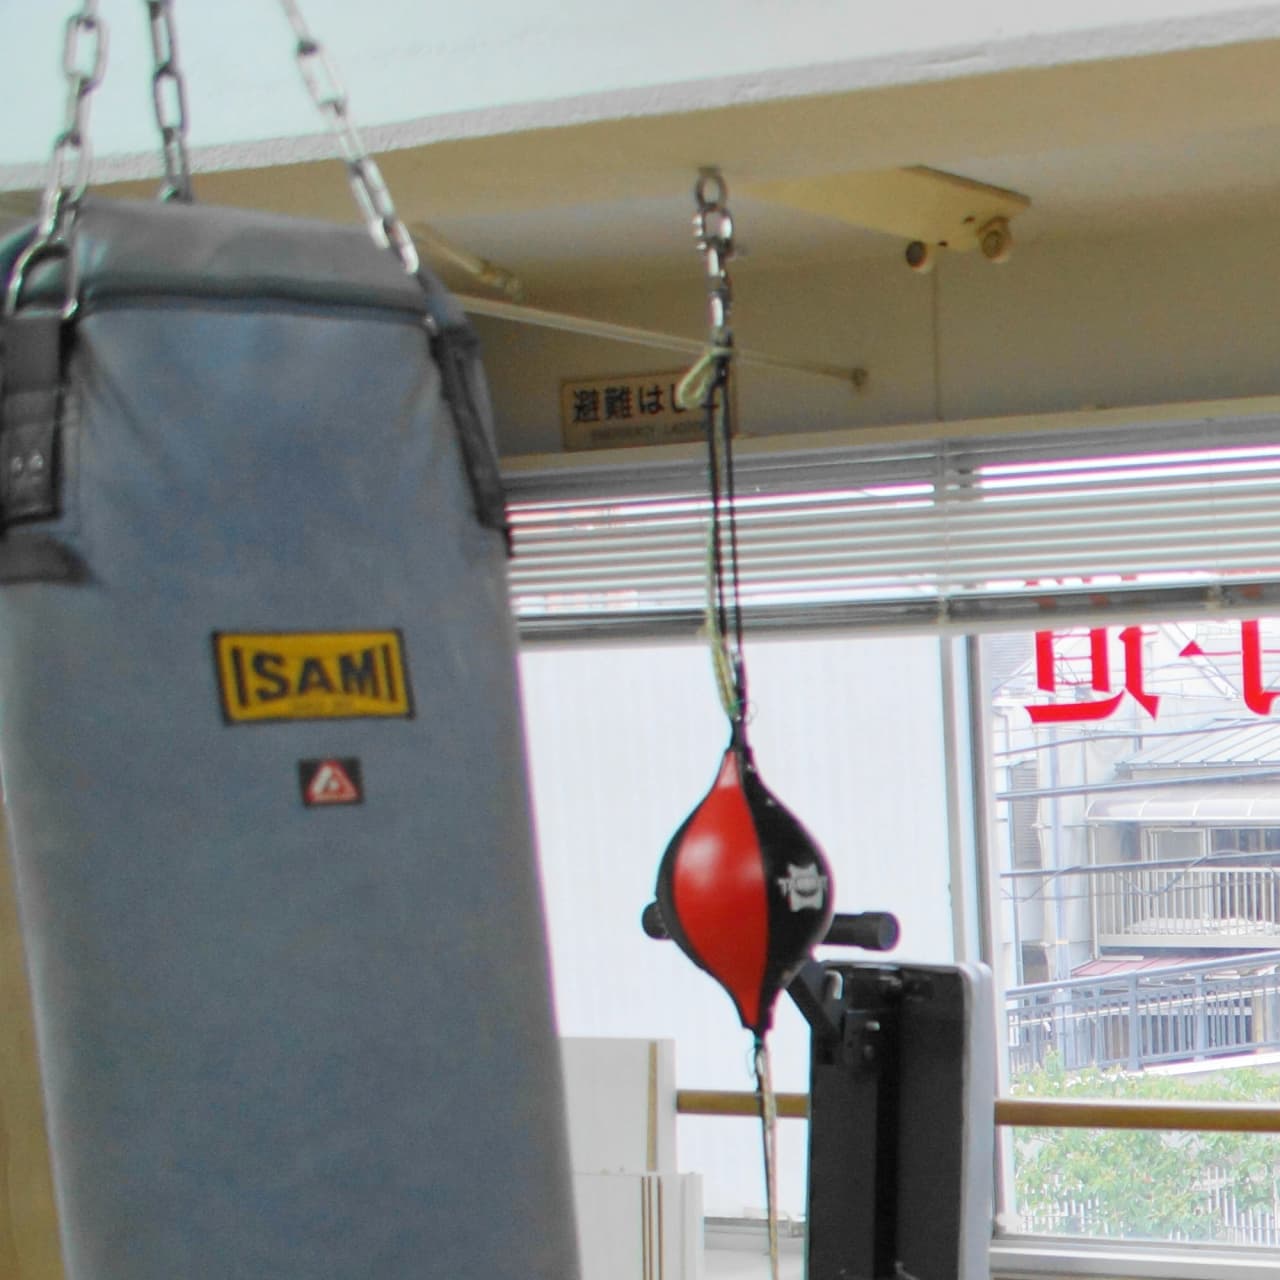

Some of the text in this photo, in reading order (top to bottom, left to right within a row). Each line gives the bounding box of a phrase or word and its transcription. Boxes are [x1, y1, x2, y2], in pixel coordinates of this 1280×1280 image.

[573, 384, 718, 423] 避難はし
[252, 648, 381, 702] SAM
